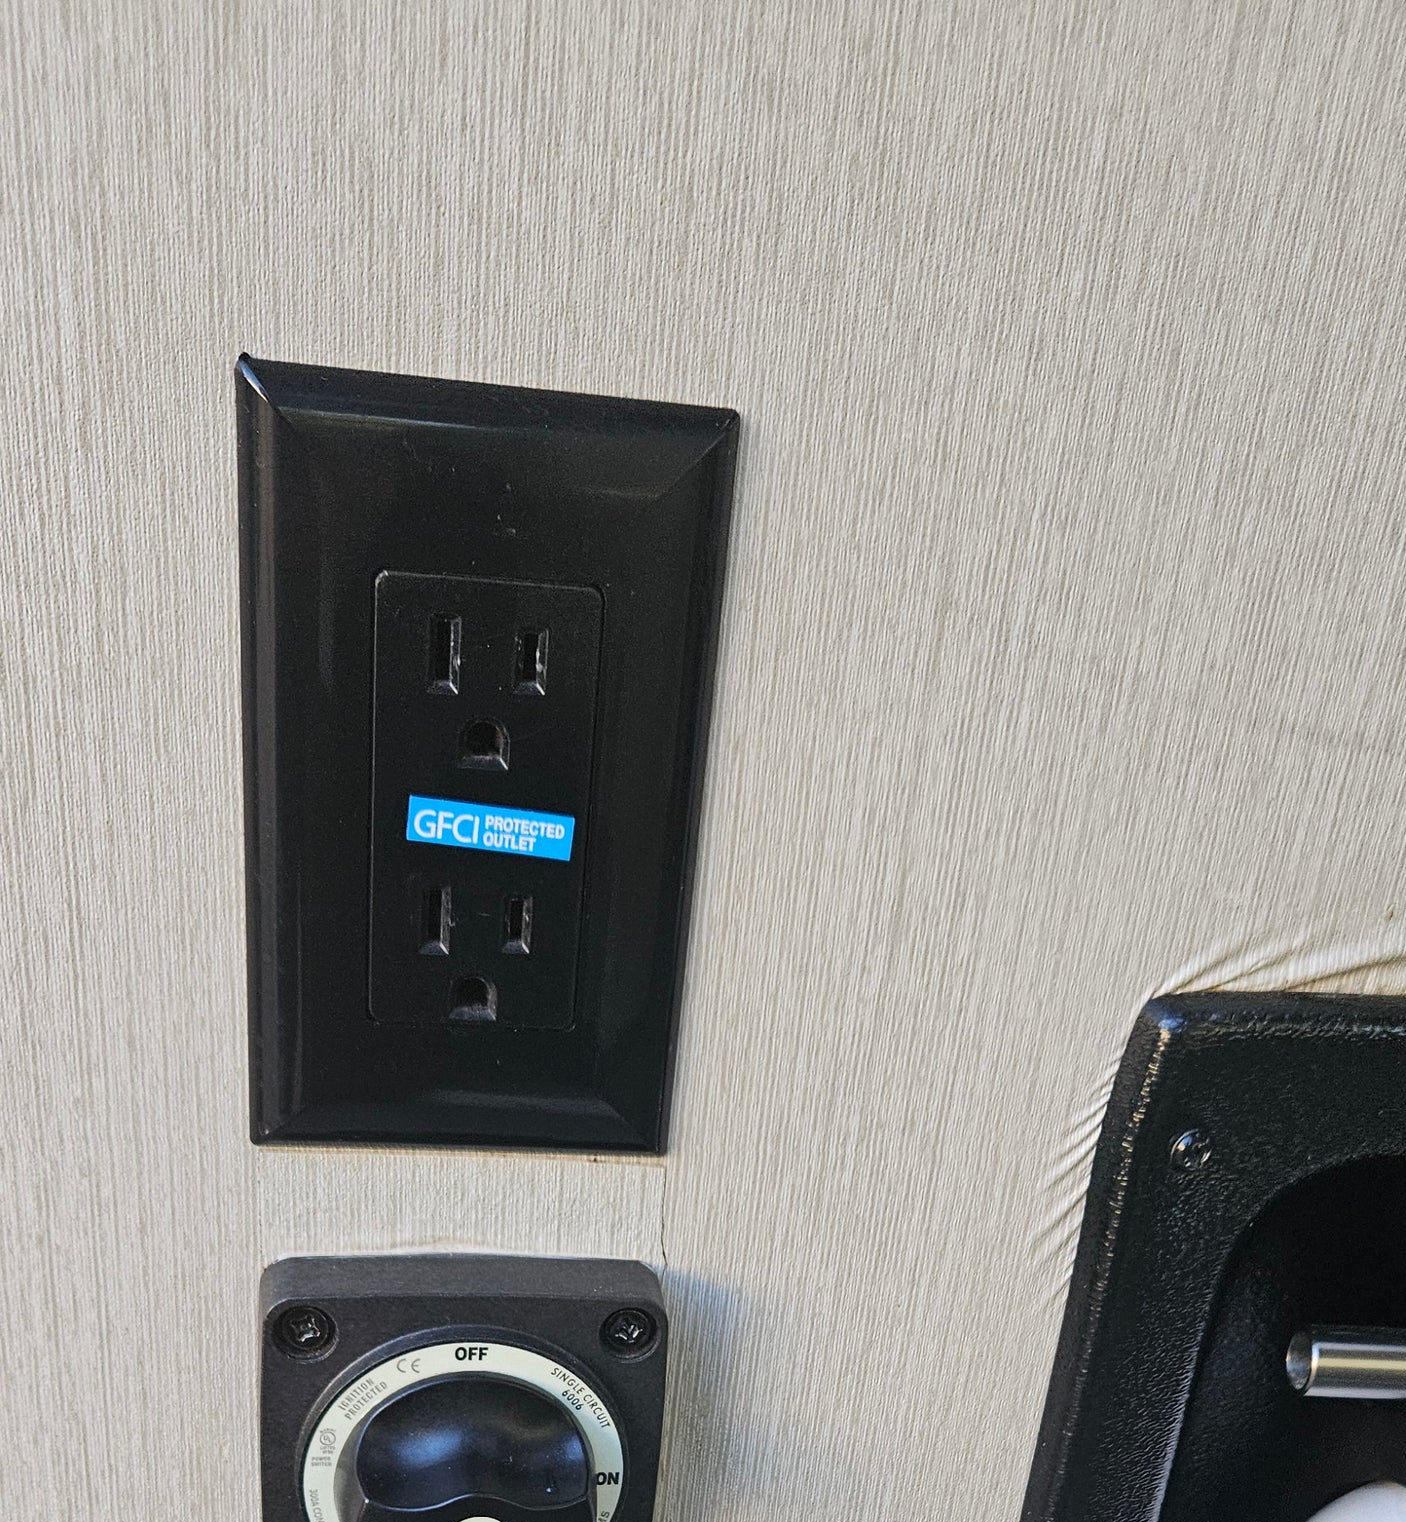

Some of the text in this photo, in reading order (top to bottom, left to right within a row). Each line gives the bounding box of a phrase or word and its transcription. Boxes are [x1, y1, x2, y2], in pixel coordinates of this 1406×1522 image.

[414, 809, 479, 844] GFCI
[484, 815, 565, 839] PROTECTED
[483, 832, 536, 852] OUTLET
[455, 1346, 488, 1361] OFF
[338, 1377, 375, 1411] IGNITION
[344, 1381, 388, 1420] PROTECTED
[551, 1367, 611, 1429] SINGLE CIRCUIT
[561, 1389, 582, 1411] 6006
[596, 1471, 619, 1486] ON
